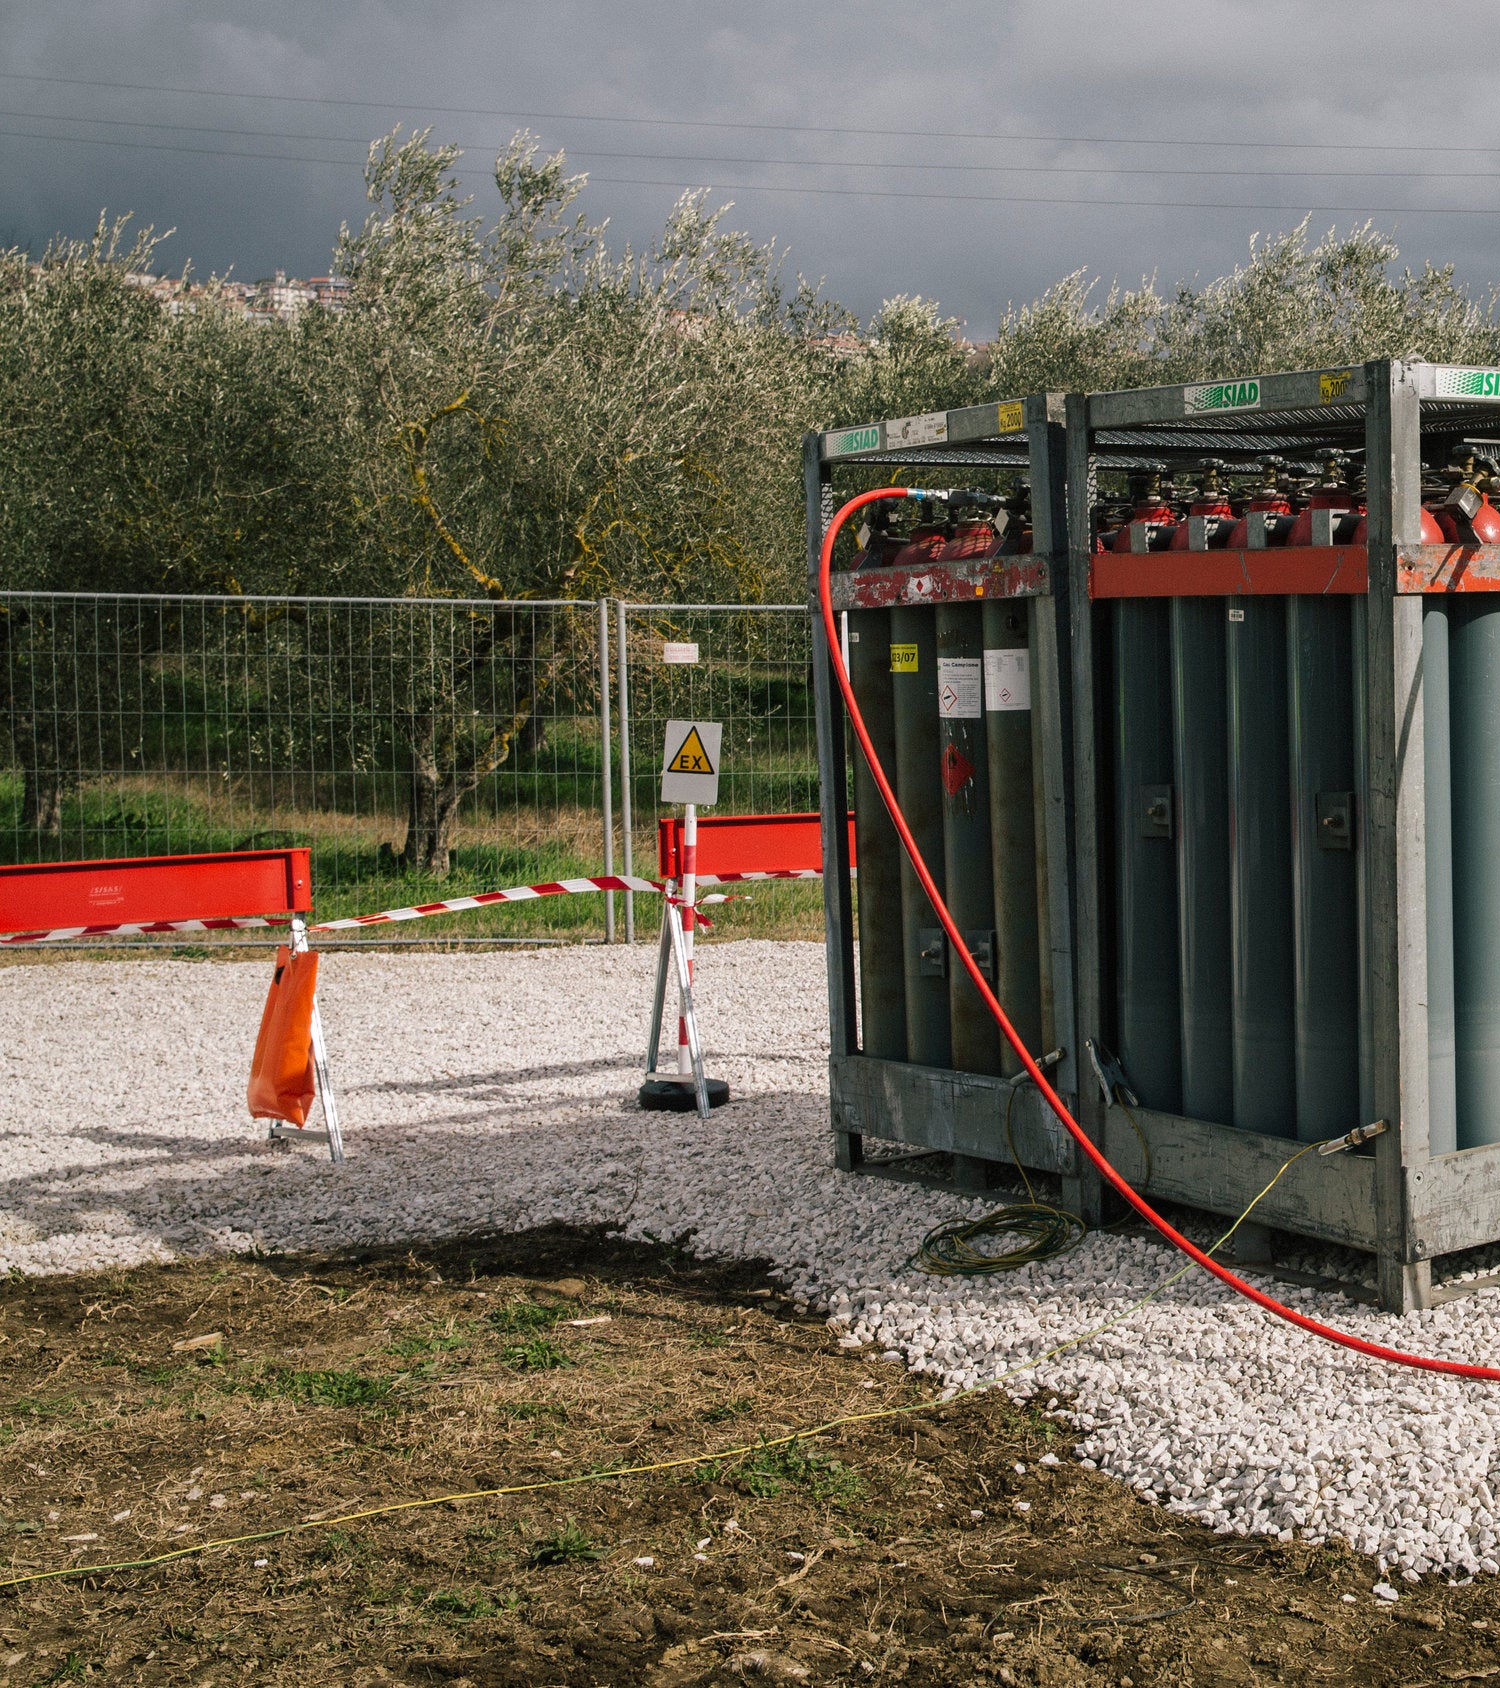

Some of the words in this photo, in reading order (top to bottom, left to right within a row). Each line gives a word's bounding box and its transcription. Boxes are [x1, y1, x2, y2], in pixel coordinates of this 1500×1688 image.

[1222, 382, 1259, 409] SIAD
[1007, 411, 1022, 428] 2000
[852, 428, 879, 452] SIAD
[680, 755, 703, 770] EX
